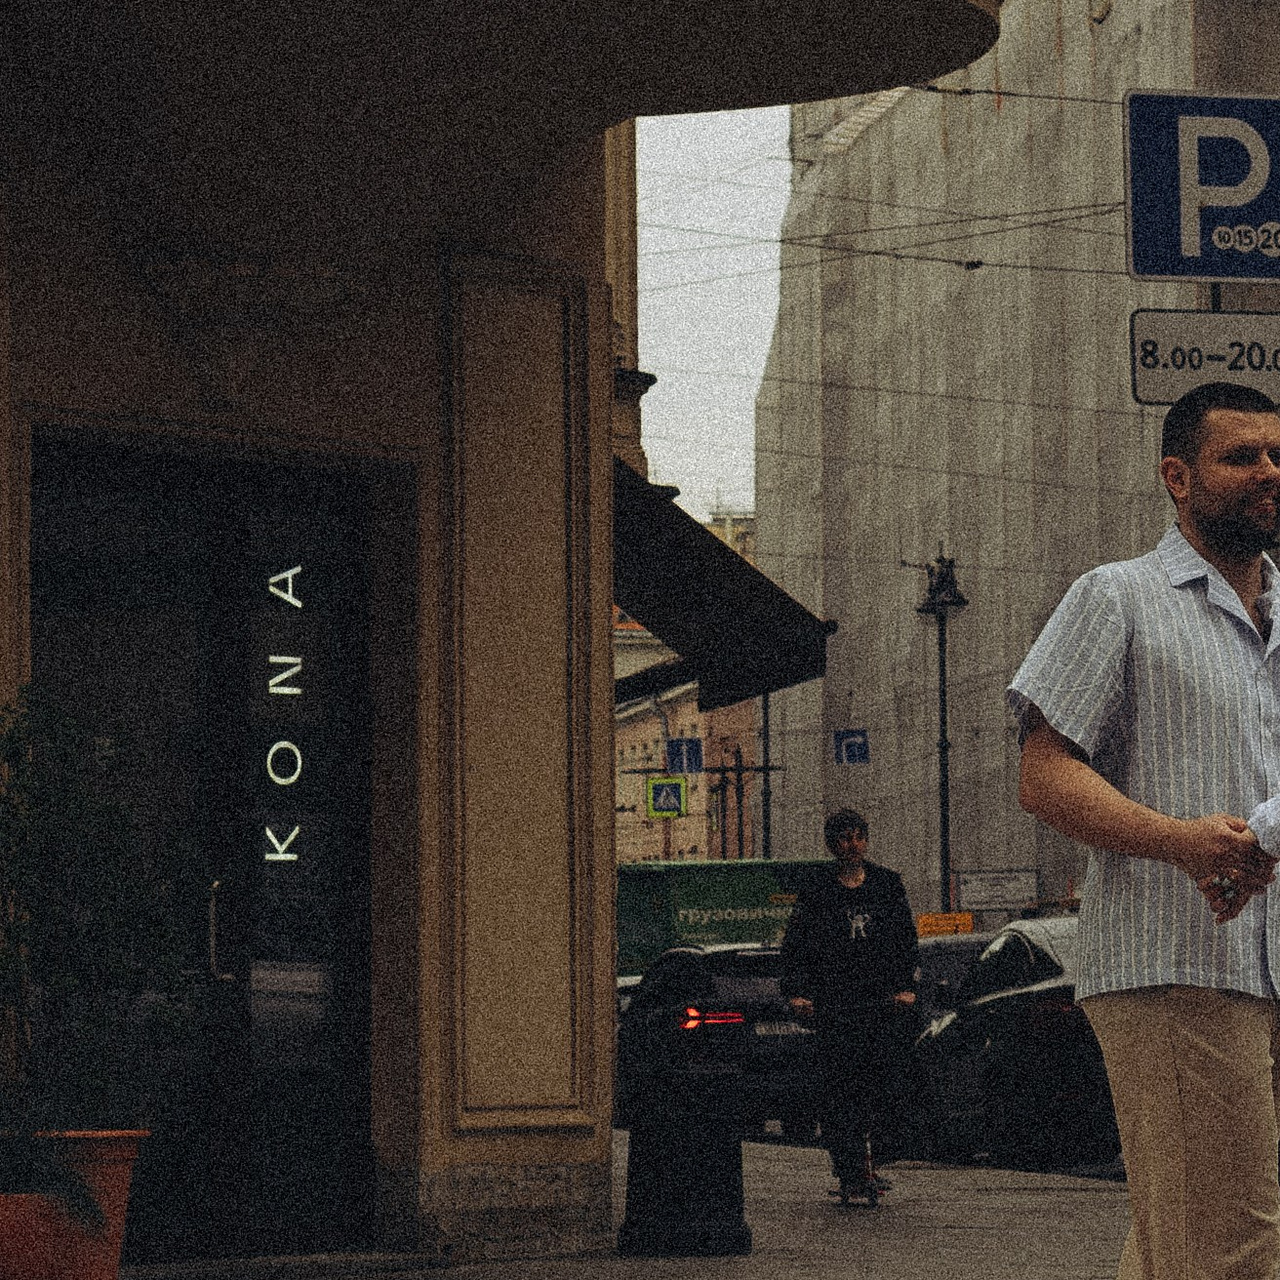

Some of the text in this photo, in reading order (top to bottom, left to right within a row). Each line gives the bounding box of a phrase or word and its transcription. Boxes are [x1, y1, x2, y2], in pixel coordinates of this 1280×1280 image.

[1177, 115, 1271, 258] P
[1236, 229, 1254, 247] 15
[265, 565, 302, 861] KONA
